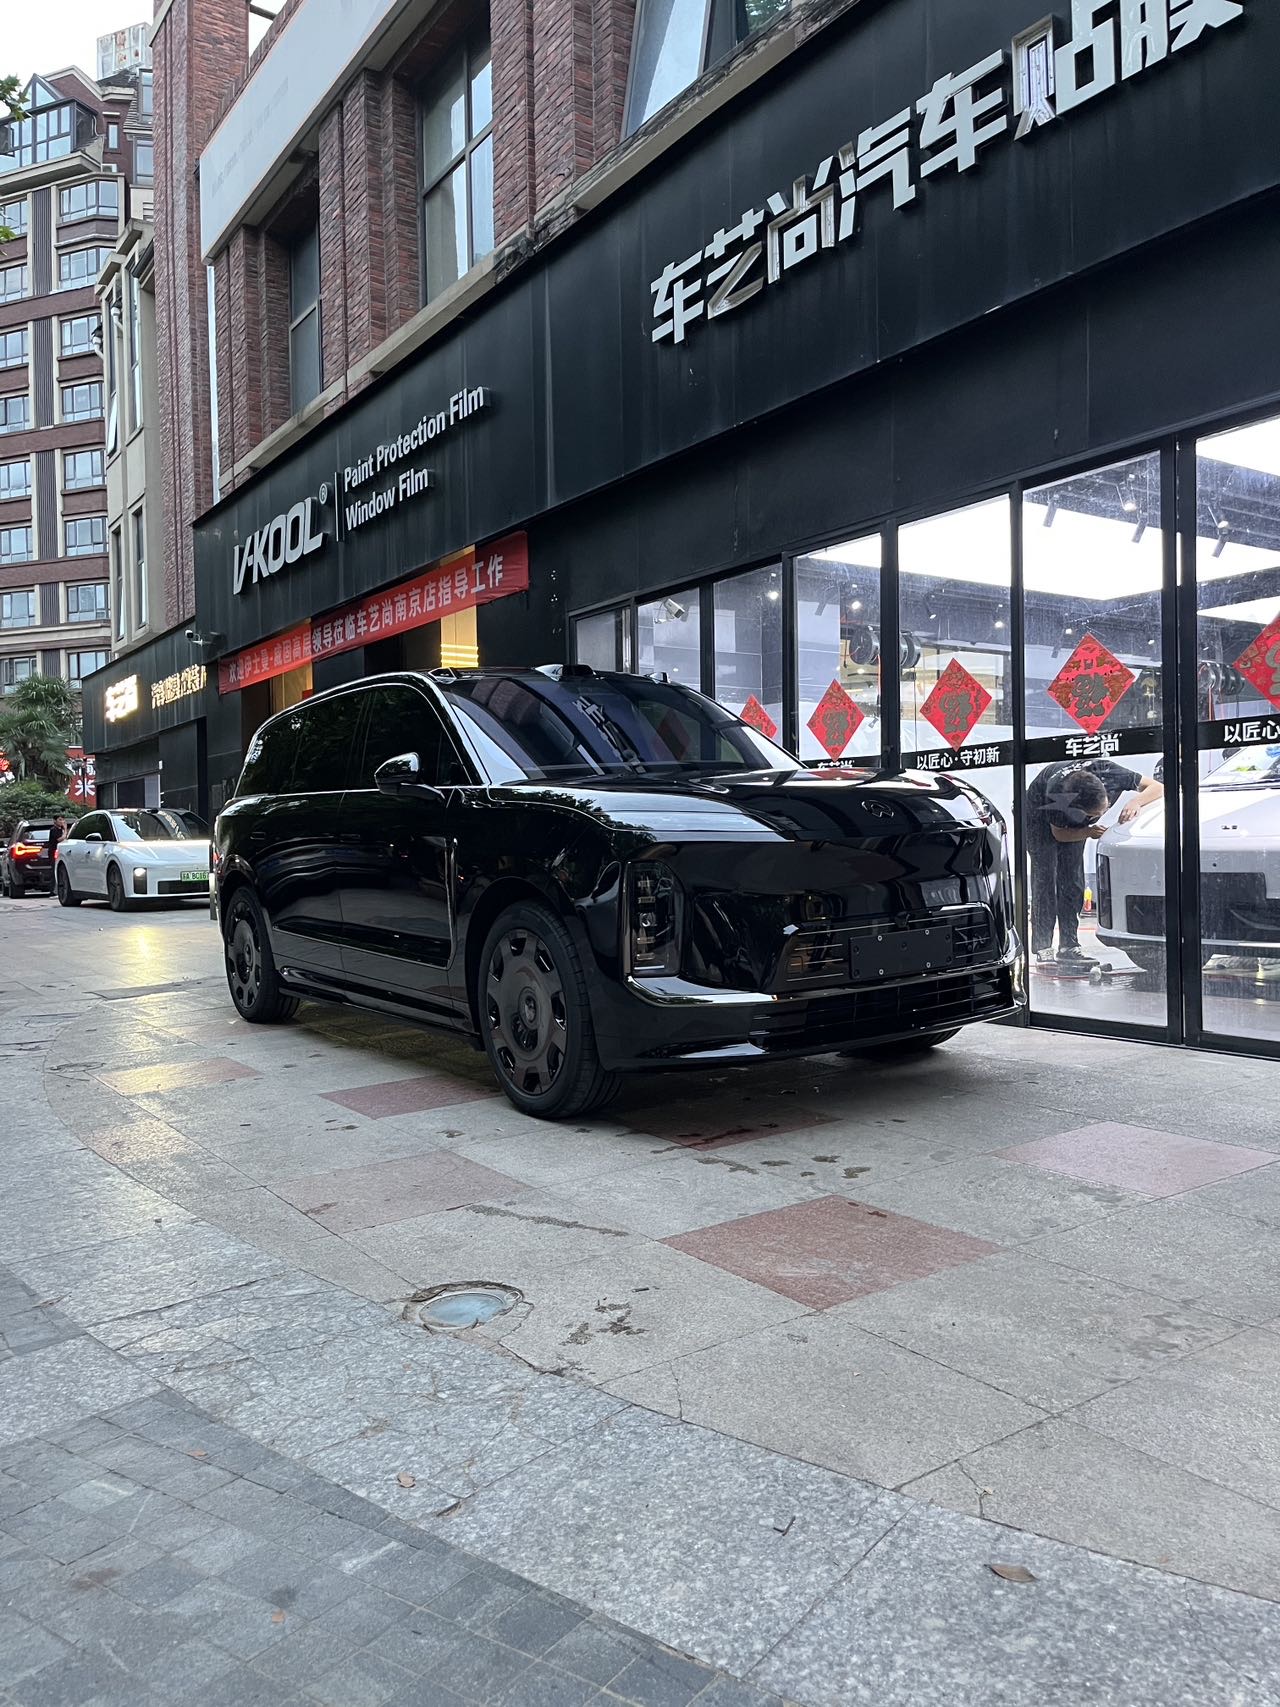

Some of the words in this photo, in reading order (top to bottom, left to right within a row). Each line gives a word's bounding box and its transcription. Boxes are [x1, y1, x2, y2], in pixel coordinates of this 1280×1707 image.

[344, 453, 374, 493] Paint
[376, 410, 446, 474] Protection
[449, 383, 485, 426] Film
[345, 486, 396, 531] Window
[398, 466, 429, 502] Film
[916, 746, 1001, 771] 以匠心·守初新
[1065, 733, 1120, 758] 车艺尚
